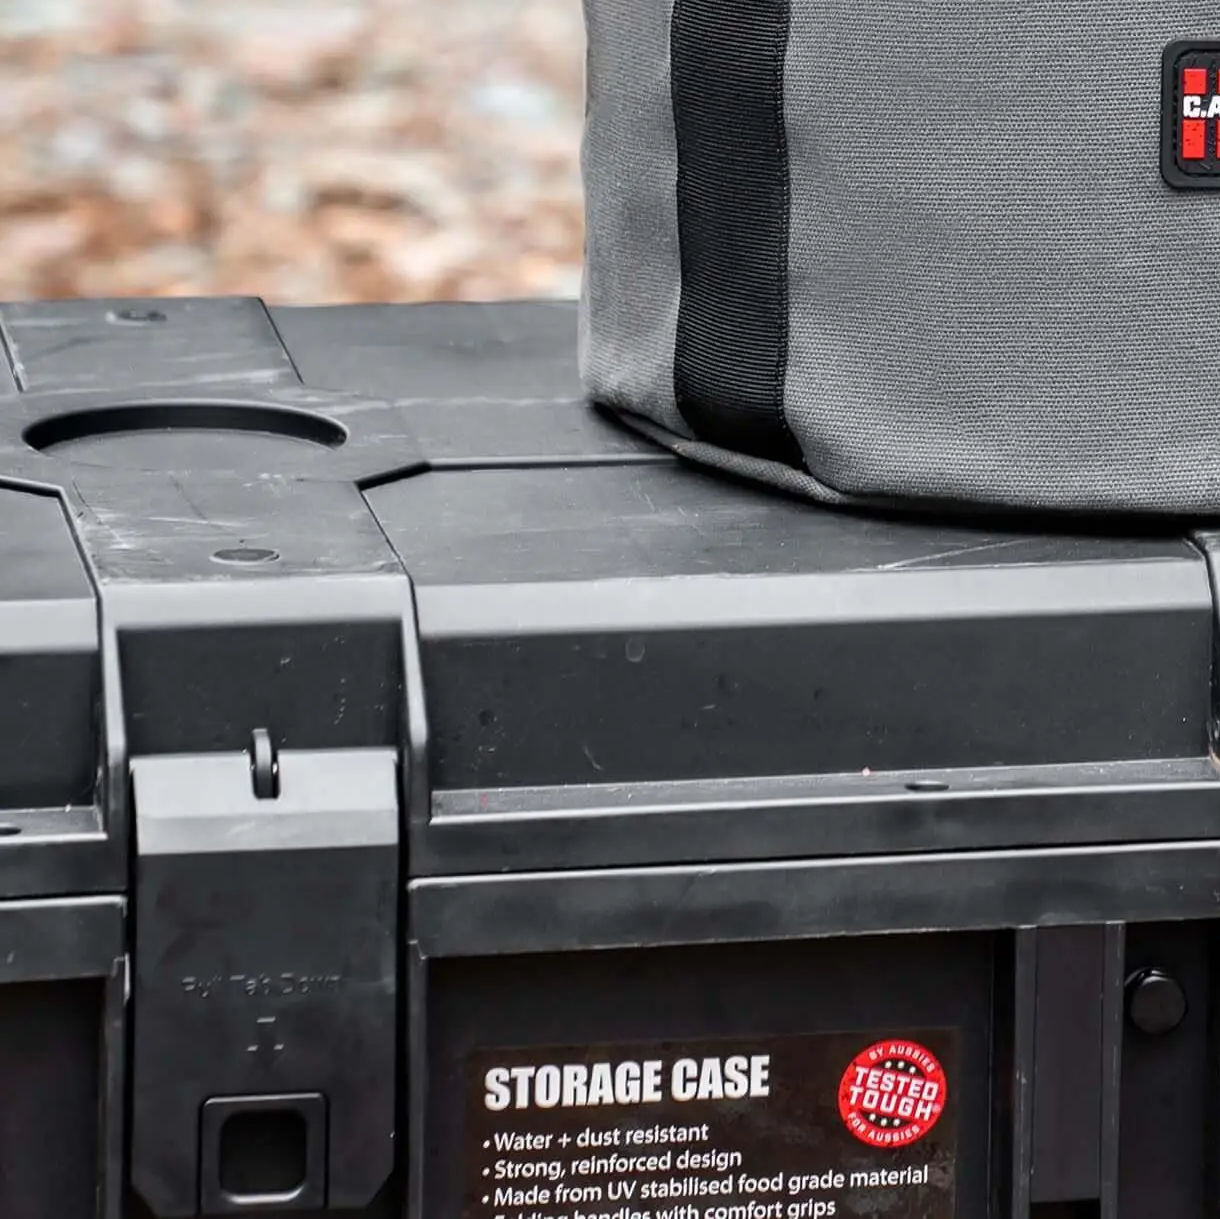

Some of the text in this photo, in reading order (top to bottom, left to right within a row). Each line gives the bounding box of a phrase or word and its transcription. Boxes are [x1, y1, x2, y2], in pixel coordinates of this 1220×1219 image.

[484, 1054, 770, 1112] STORAGE CASE
[855, 1066, 939, 1101] TESTED
[494, 1131, 553, 1152] Water
[576, 1127, 621, 1148] dust
[625, 1123, 709, 1145] resistant
[848, 1111, 867, 1133] FOR
[494, 1148, 742, 1181] Strong, reinforced design
[494, 1164, 928, 1207] Made from UV stabilised food grade material
[656, 1203, 700, 1219] with
[704, 1199, 783, 1219] comfort
[787, 1198, 836, 1219] grips
